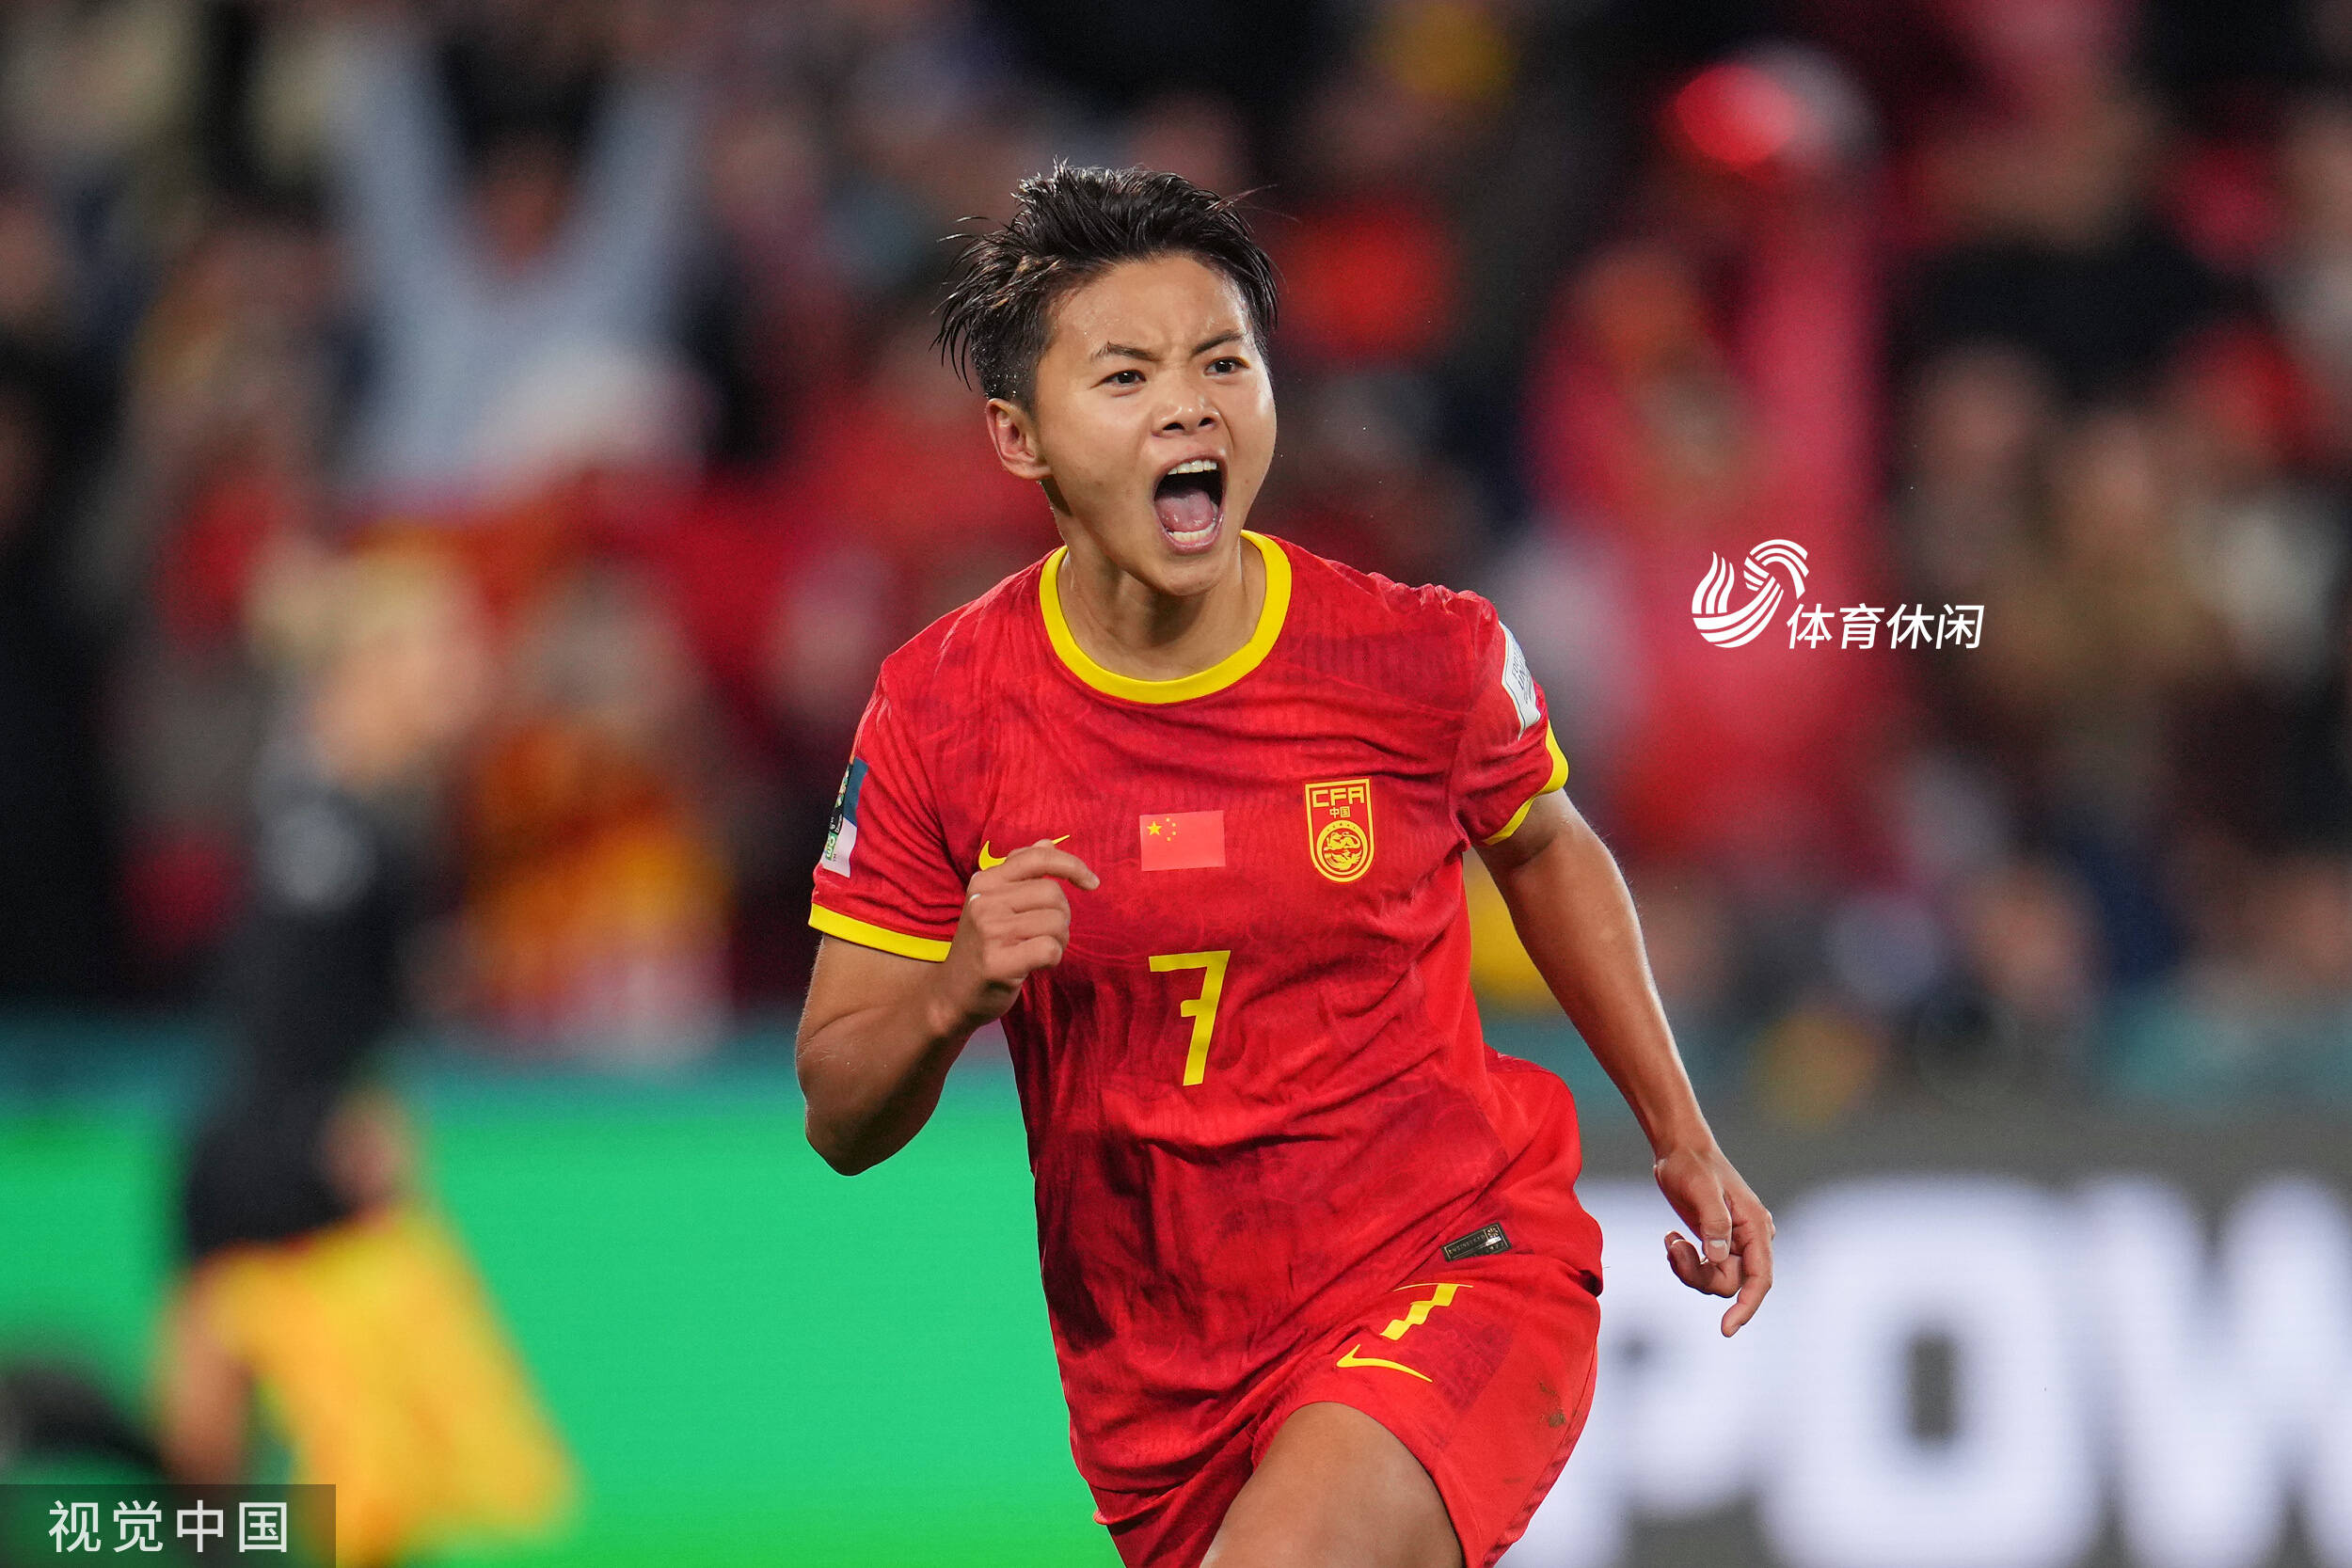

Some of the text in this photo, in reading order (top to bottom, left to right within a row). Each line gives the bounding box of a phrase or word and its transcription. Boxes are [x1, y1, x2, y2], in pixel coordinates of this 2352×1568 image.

[1311, 785, 1365, 808] CFA
[1329, 806, 1351, 818] 中国
[1148, 950, 1232, 1086] 7
[1379, 1282, 1474, 1341] 7
